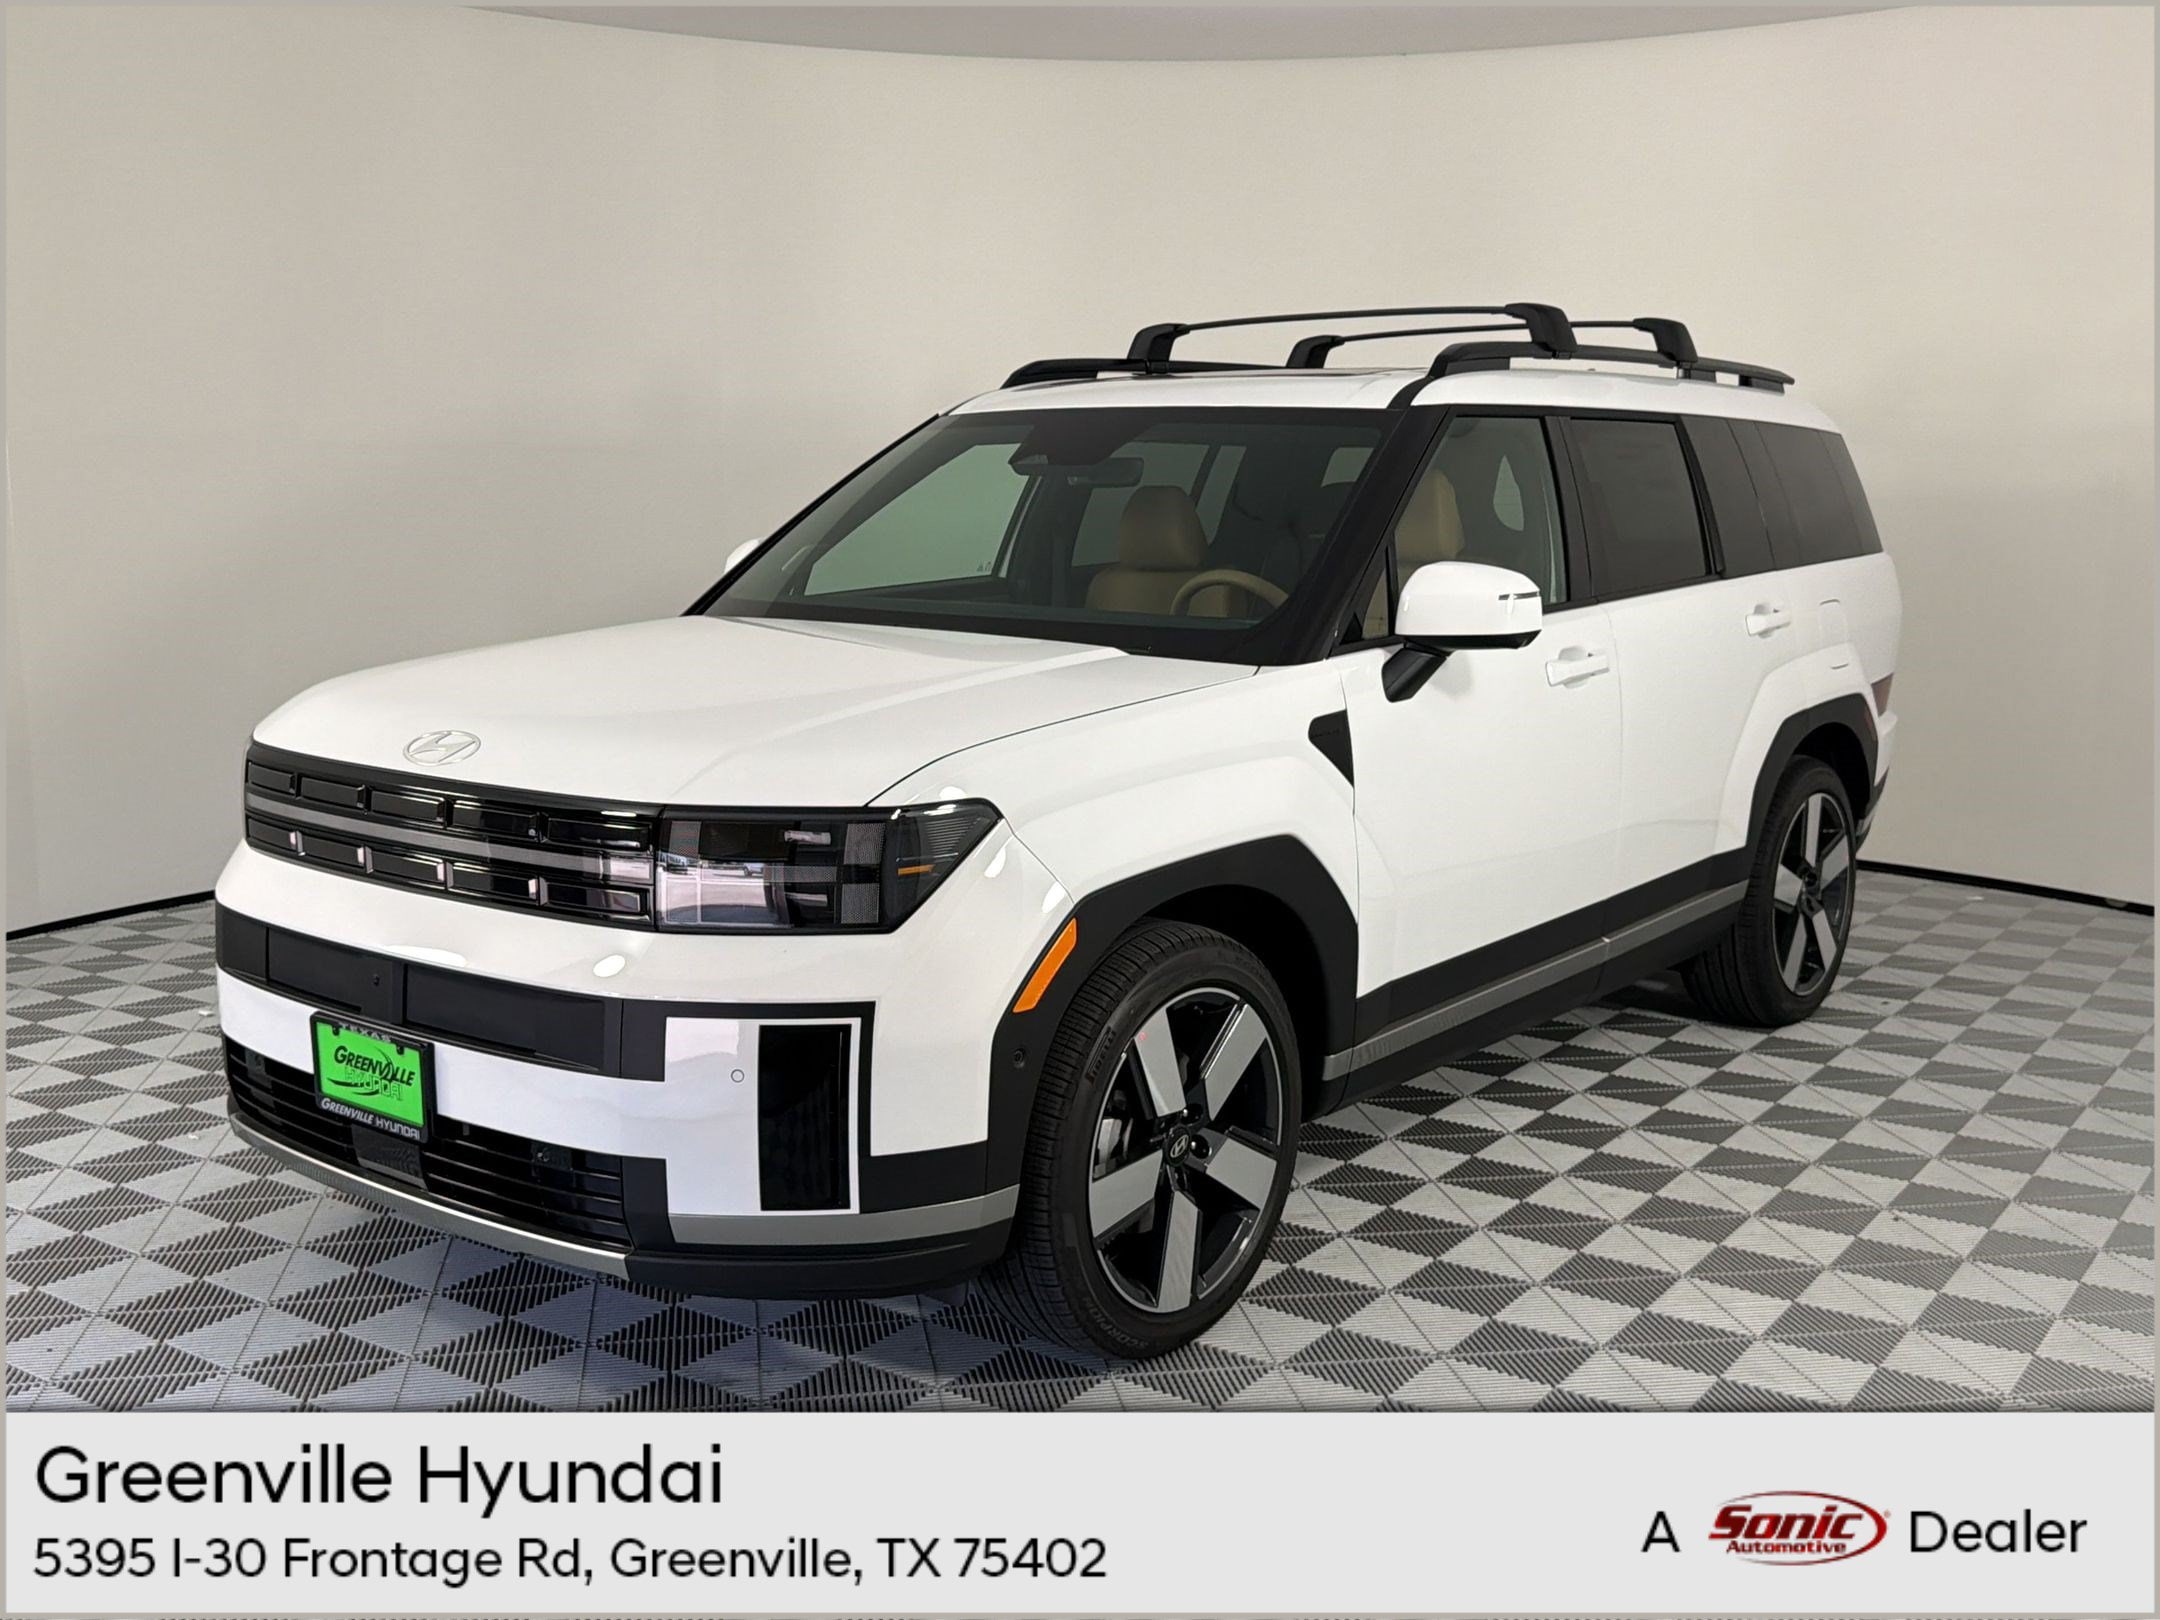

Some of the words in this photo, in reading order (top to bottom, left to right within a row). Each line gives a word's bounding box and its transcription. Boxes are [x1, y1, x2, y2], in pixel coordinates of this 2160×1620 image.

[339, 1022, 392, 1043] TEXAS
[333, 1045, 417, 1087] GREENVILLE
[320, 1097, 375, 1125] GREENVILLE
[375, 1115, 421, 1141] HYUNDAI
